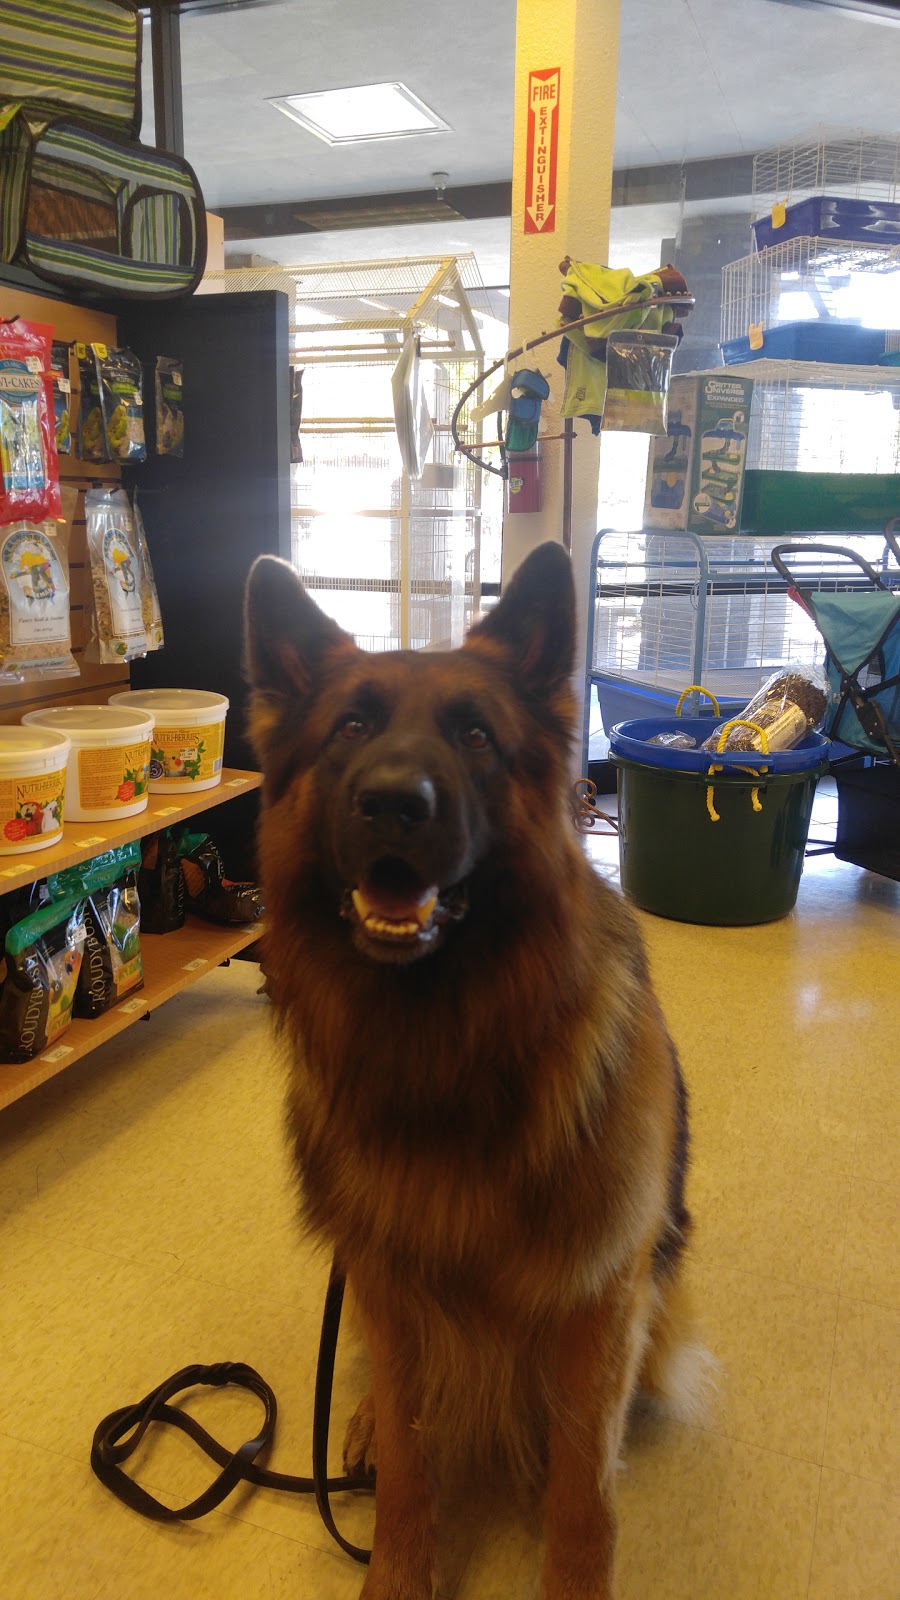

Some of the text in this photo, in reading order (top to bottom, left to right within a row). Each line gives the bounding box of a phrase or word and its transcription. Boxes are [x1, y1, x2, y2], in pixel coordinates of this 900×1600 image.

[533, 84, 556, 101] FIRE
[535, 106, 548, 221] EXTINGUISHER
[705, 386, 745, 396] UNIVERSE
[708, 380, 742, 389] CRITTER
